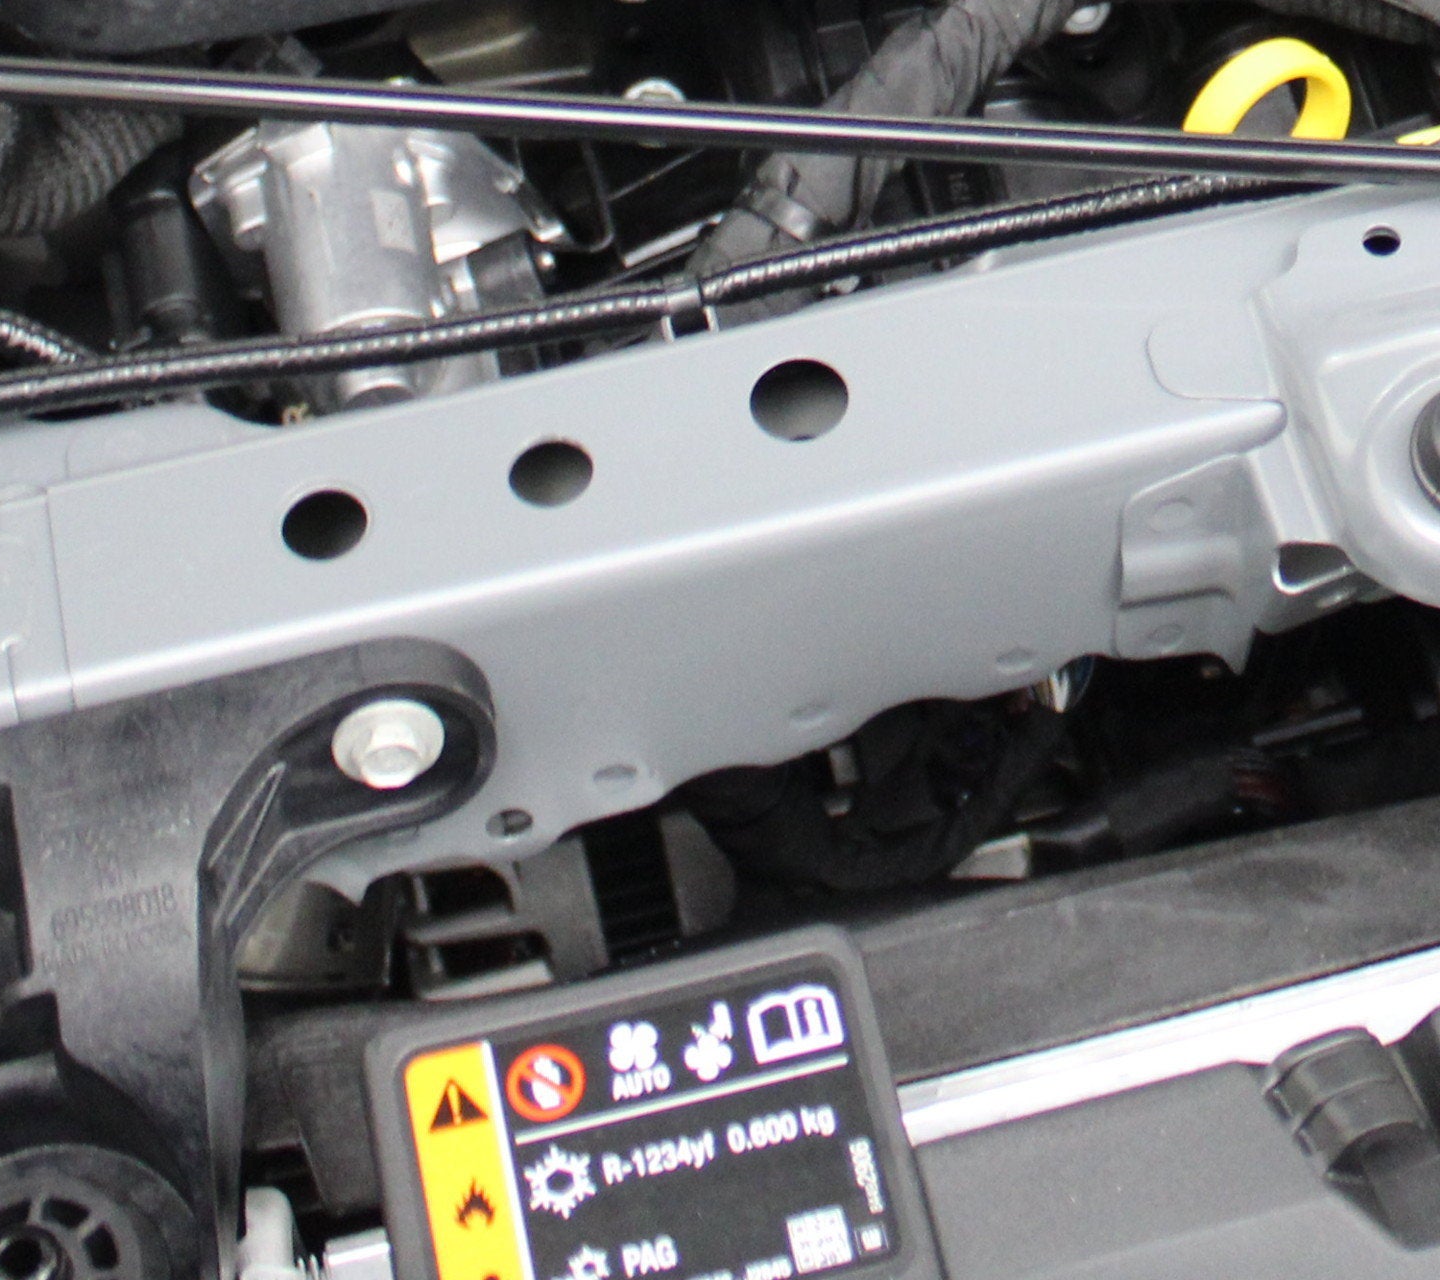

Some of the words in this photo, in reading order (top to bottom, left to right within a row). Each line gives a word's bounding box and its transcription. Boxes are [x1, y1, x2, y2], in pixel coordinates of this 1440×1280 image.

[613, 1062, 671, 1101] AUTO
[602, 1130, 715, 1185] R-1234yf
[800, 1104, 837, 1137] kg
[622, 1234, 679, 1278] PAG
